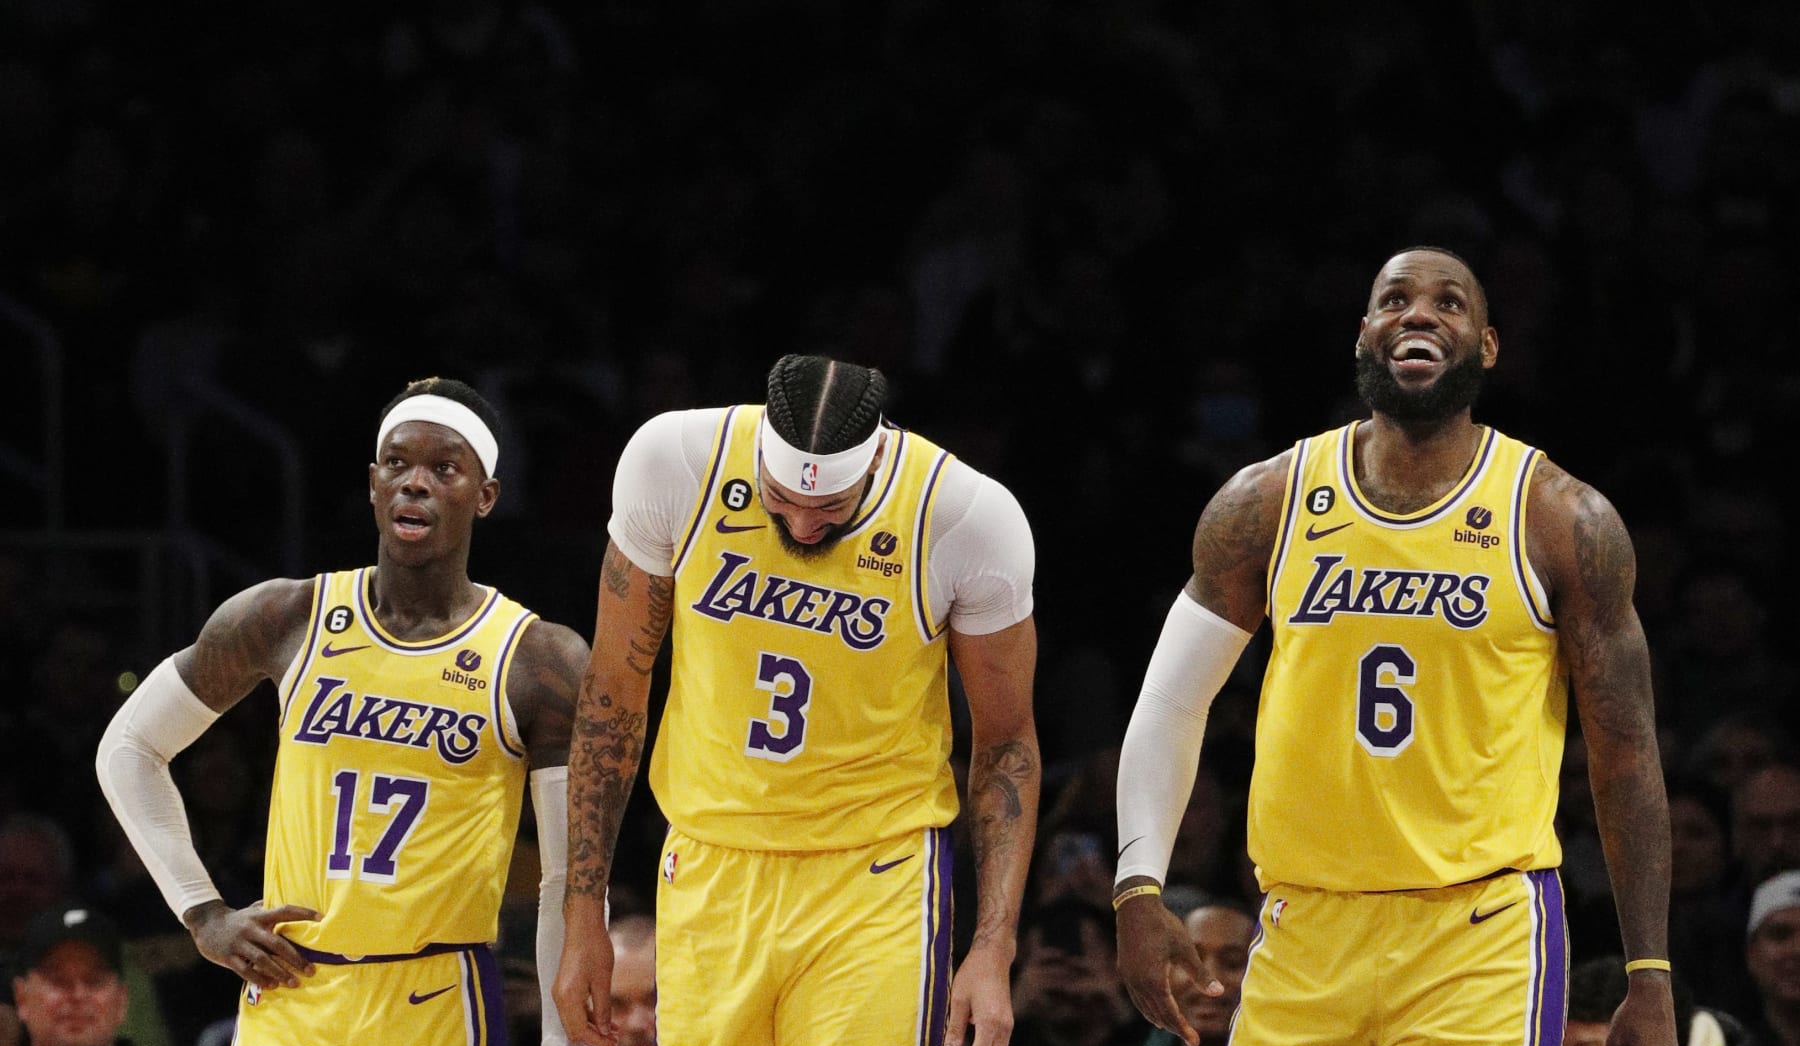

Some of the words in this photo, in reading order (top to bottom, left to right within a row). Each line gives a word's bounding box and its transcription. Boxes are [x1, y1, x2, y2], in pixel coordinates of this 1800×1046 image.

[727, 483, 747, 508] 6
[1313, 490, 1330, 512] 6
[1454, 529, 1500, 549] bibigo
[857, 555, 904, 577] bibigo
[691, 550, 892, 652] LAKERS
[1288, 554, 1492, 631] LAKERS
[330, 609, 348, 631] 6
[442, 668, 487, 691] bibigo
[1355, 643, 1417, 758] 6
[293, 676, 488, 766] LAKERS
[744, 650, 814, 763] 3
[326, 768, 431, 884] 17
